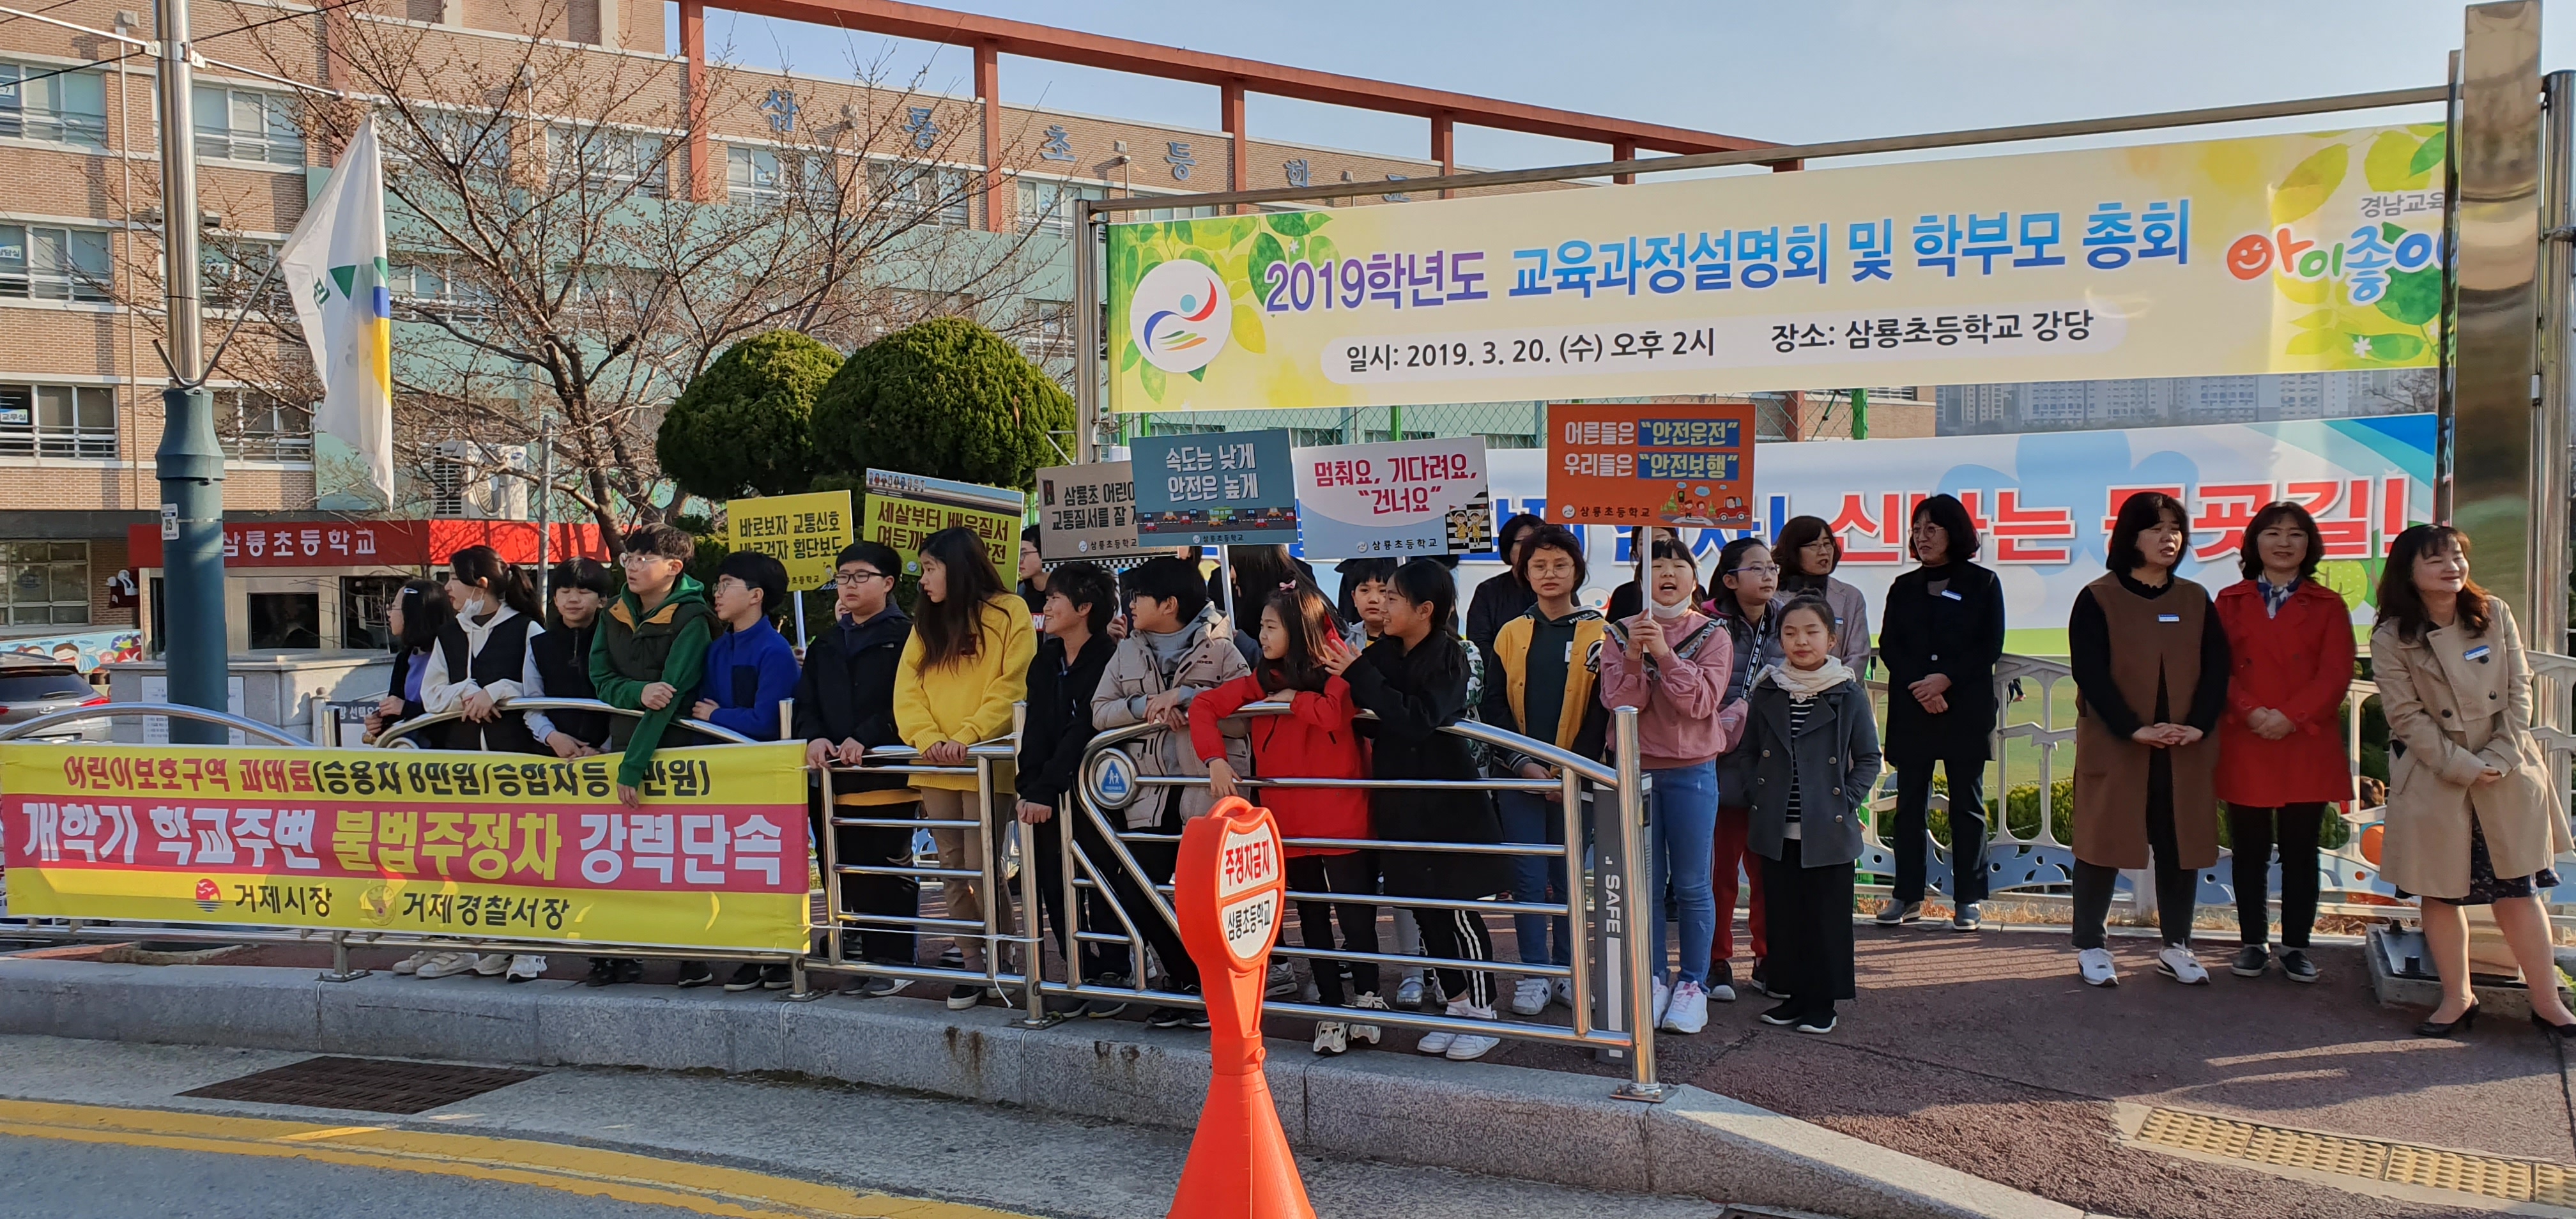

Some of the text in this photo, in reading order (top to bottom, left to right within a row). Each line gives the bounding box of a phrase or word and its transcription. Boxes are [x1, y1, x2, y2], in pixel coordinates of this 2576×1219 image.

[1266, 199, 2189, 312] 2019학년도 교육과정설명회 및 학부모 총회
[1771, 309, 2094, 353] 장소: 삼룡초등학교 강당
[1347, 327, 1715, 372] 일시: 2019. 3. 20. (수) 오후 2시
[1565, 422, 1634, 445] 어른들은
[1166, 443, 1256, 472] 속도는 낮게
[1314, 454, 1477, 487] 멈춰요, 기다려요,
[1563, 453, 1633, 477] 우리들은
[1064, 484, 1099, 507] 삼룡초
[1168, 473, 1259, 502] 안전은 높게
[739, 511, 841, 538] 바로보자 교통신호
[877, 500, 1009, 542] 세살부터 배운질서
[1052, 507, 1109, 530] 교통질서를
[1114, 505, 1126, 526] 잘
[1580, 506, 1651, 518] 삼룡초등학교
[2104, 477, 2409, 560] 굣길!
[223, 529, 376, 557] 삼룡초등학교
[793, 536, 843, 560] 횡단보도
[877, 525, 929, 551] 여든까
[1091, 538, 1138, 551] 삼룡초등학교
[1203, 534, 1245, 543] 삼룡초등학교
[1372, 539, 1438, 551] 삼룡초등학교
[986, 541, 1007, 565] 전
[787, 575, 820, 585] 초등학교
[64, 755, 231, 793] 어린이보호구역
[641, 759, 710, 797] 만원)
[22, 802, 782, 885] 개학기 학교주변 불법주정차 강력단속
[234, 884, 571, 931] 거제시장 거제경찰서장
[1606, 874, 1621, 933] SAFE
[1227, 900, 1271, 942] 삼룡초등학교
